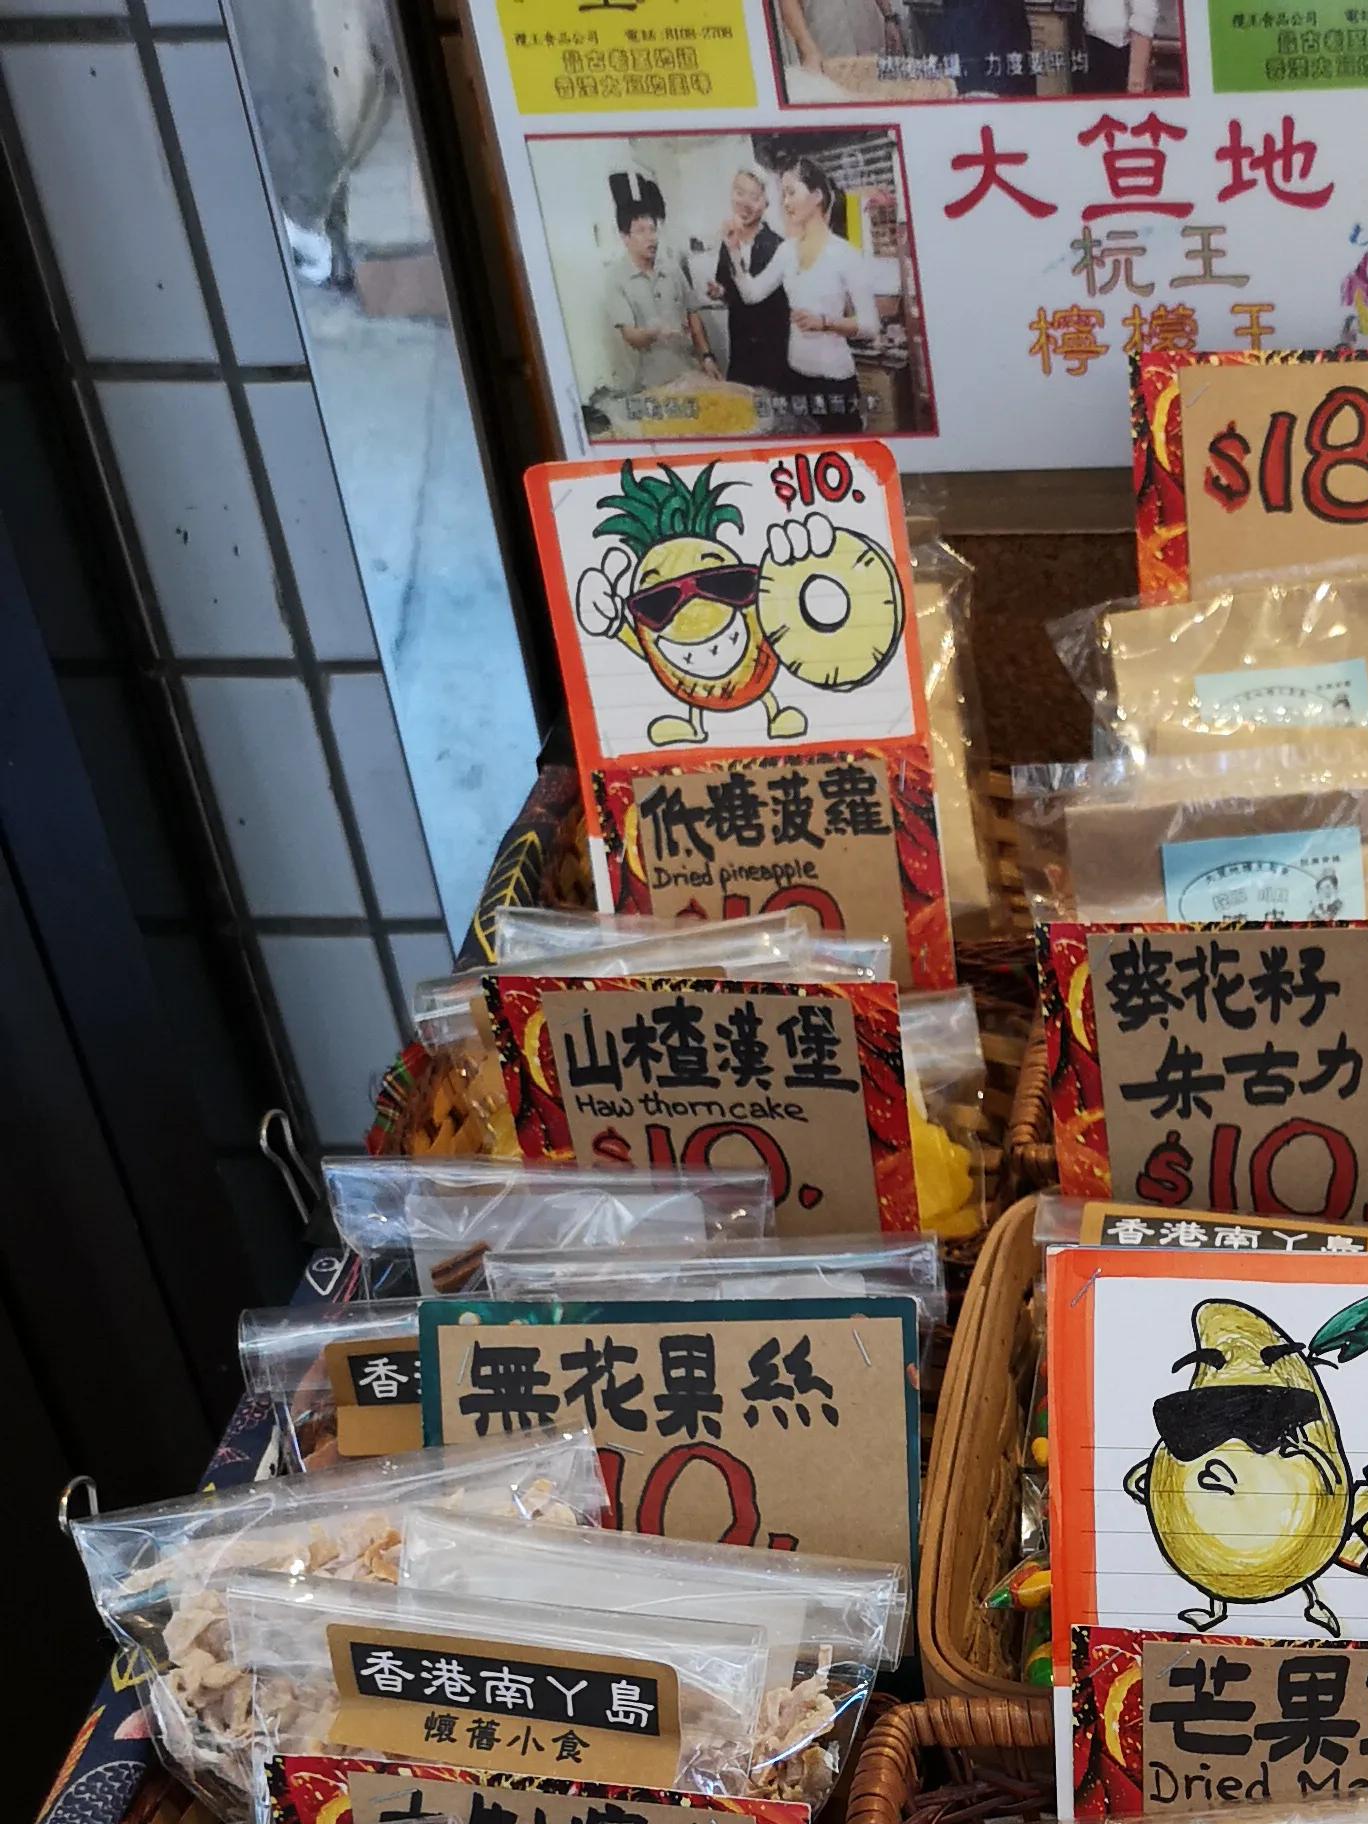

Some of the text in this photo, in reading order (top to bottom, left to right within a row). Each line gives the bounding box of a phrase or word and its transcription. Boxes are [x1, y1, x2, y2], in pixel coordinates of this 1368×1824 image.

[943, 111, 1336, 221] 大笪地
[769, 451, 866, 512] $10.
[653, 858, 818, 892] Dried pineapple
[1105, 938, 1341, 1034] 葵花籽
[564, 997, 861, 1094] 山楂漢堡
[1120, 1031, 1364, 1120] 朱古力
[360, 1649, 656, 1730] 香港南丫島
[423, 1711, 592, 1764] 懷舊小食
[1148, 1761, 1272, 1804] Dried
